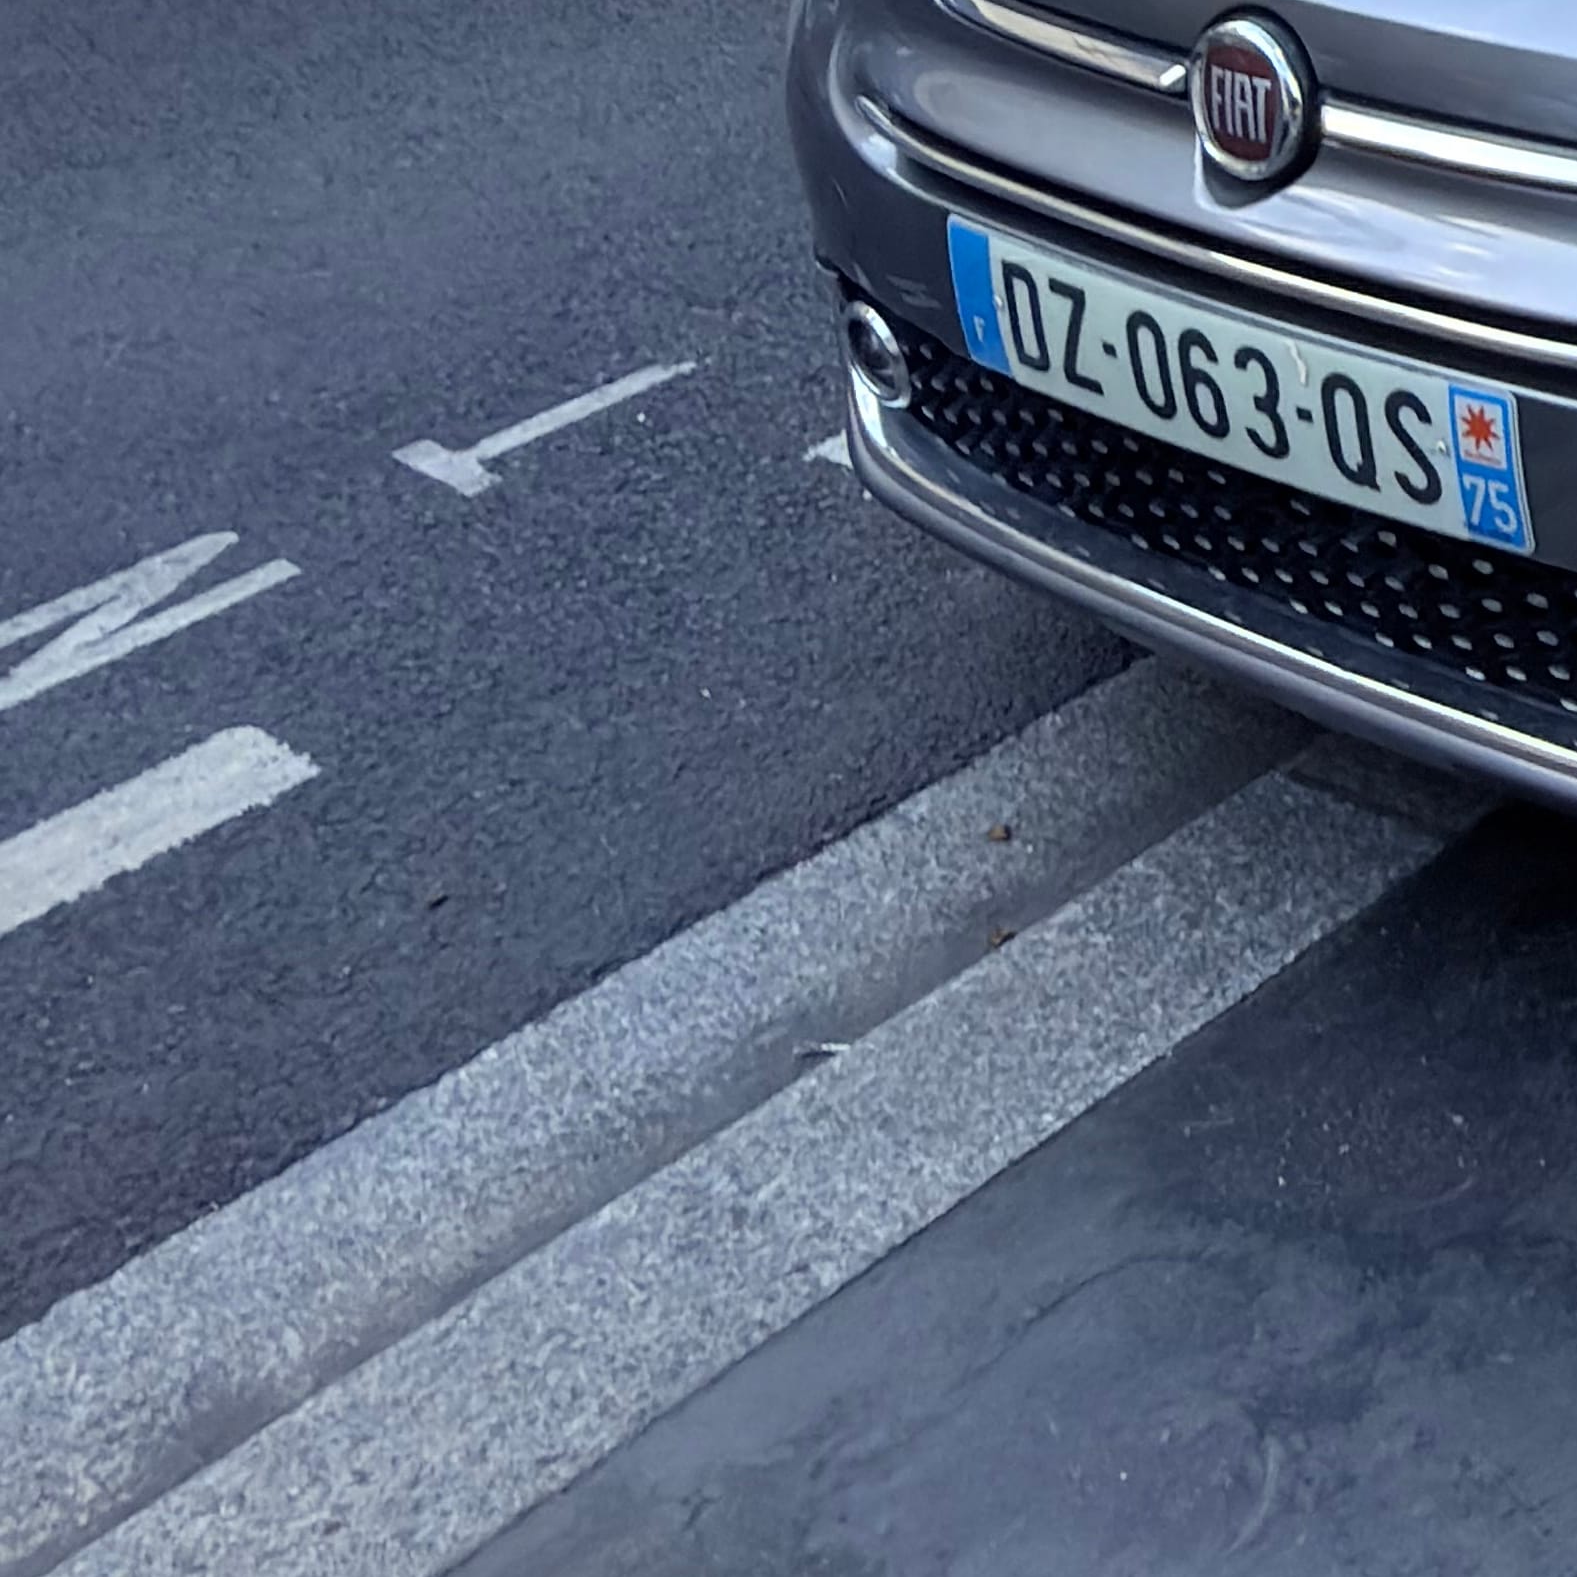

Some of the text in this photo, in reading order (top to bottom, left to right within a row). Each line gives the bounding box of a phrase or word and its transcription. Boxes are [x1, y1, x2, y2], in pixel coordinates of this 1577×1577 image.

[1210, 64, 1272, 144] FIAT
[1001, 259, 1442, 505] DZ-063-QS
[1462, 473, 1518, 534] 75
